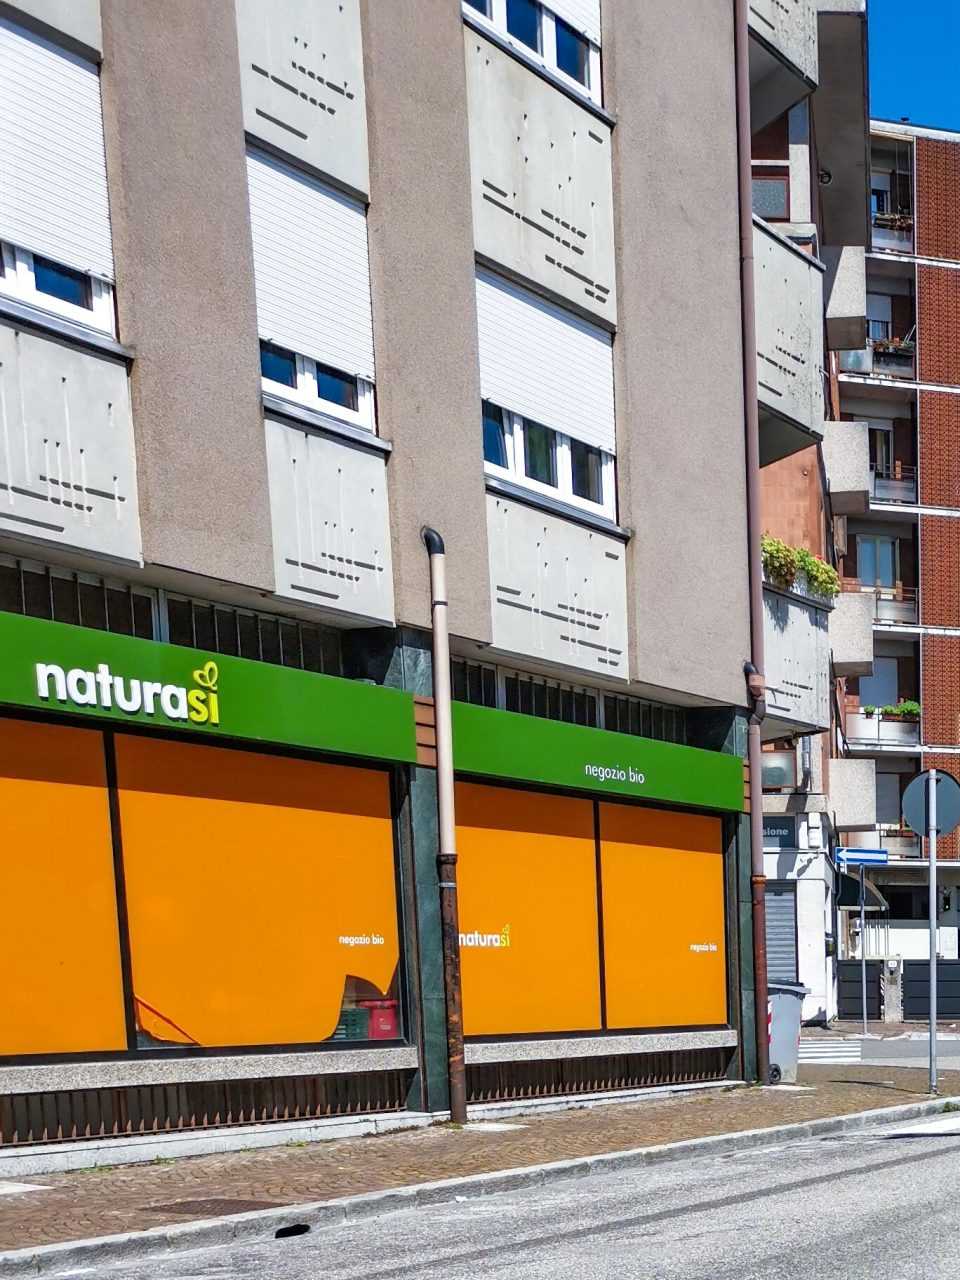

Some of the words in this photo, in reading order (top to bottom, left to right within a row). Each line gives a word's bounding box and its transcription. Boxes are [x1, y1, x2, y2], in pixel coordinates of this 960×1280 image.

[585, 764, 626, 782] negozio
[628, 766, 645, 784] bio
[338, 933, 370, 947] negozio
[371, 932, 385, 945] bio
